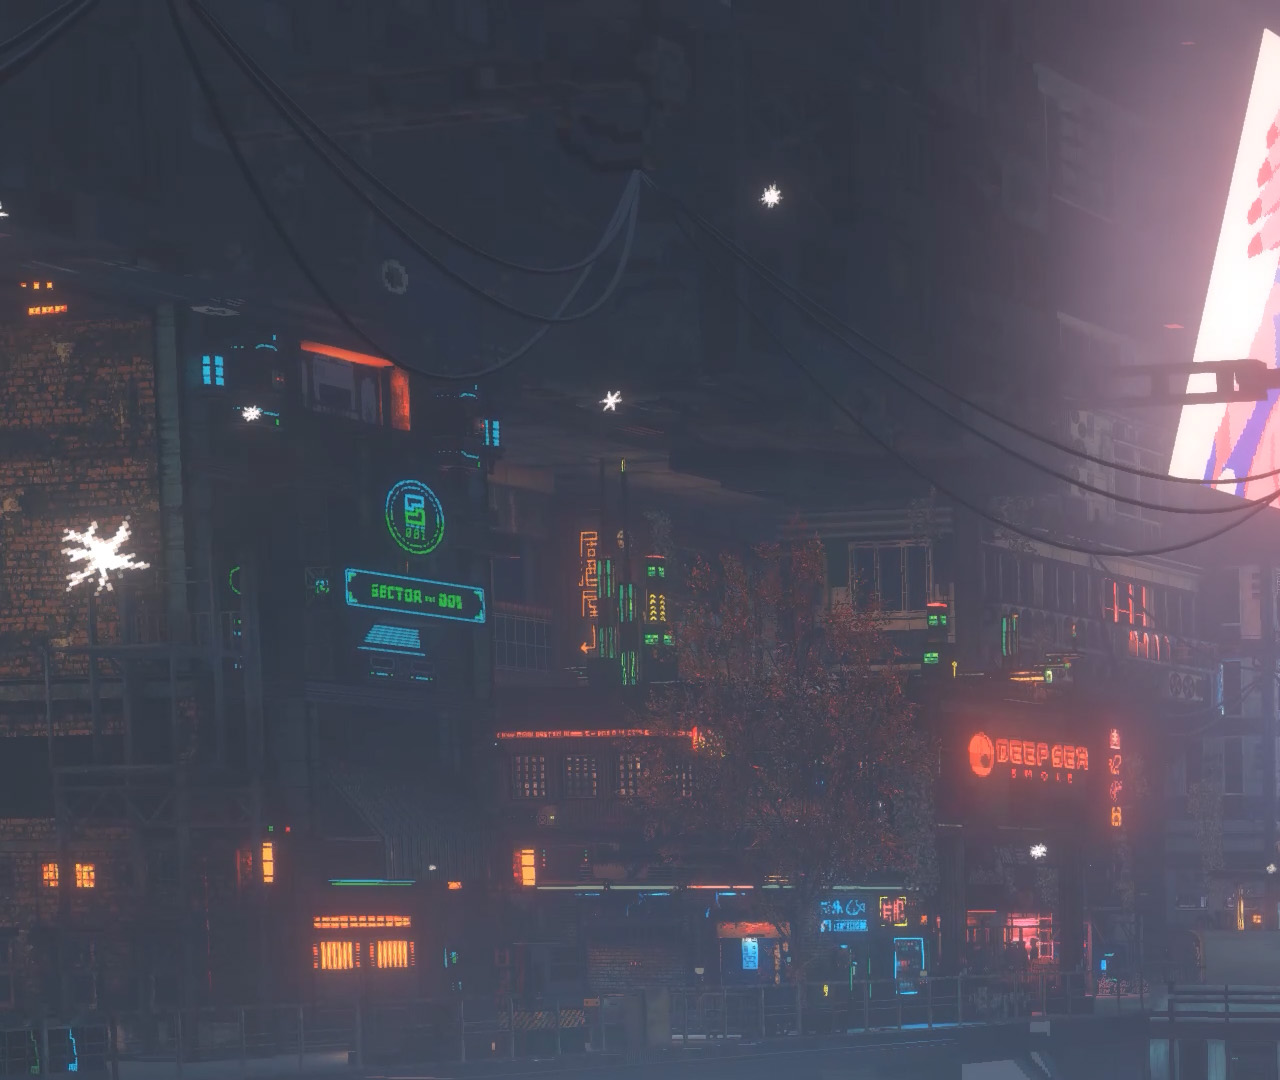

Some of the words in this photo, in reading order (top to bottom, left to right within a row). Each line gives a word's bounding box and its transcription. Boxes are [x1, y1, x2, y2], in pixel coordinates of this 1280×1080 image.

[578, 531, 599, 618] 居酒屋
[371, 583, 423, 604] SECTOR
[995, 738, 1050, 767] DEEP
[1051, 744, 1089, 771] SEA
